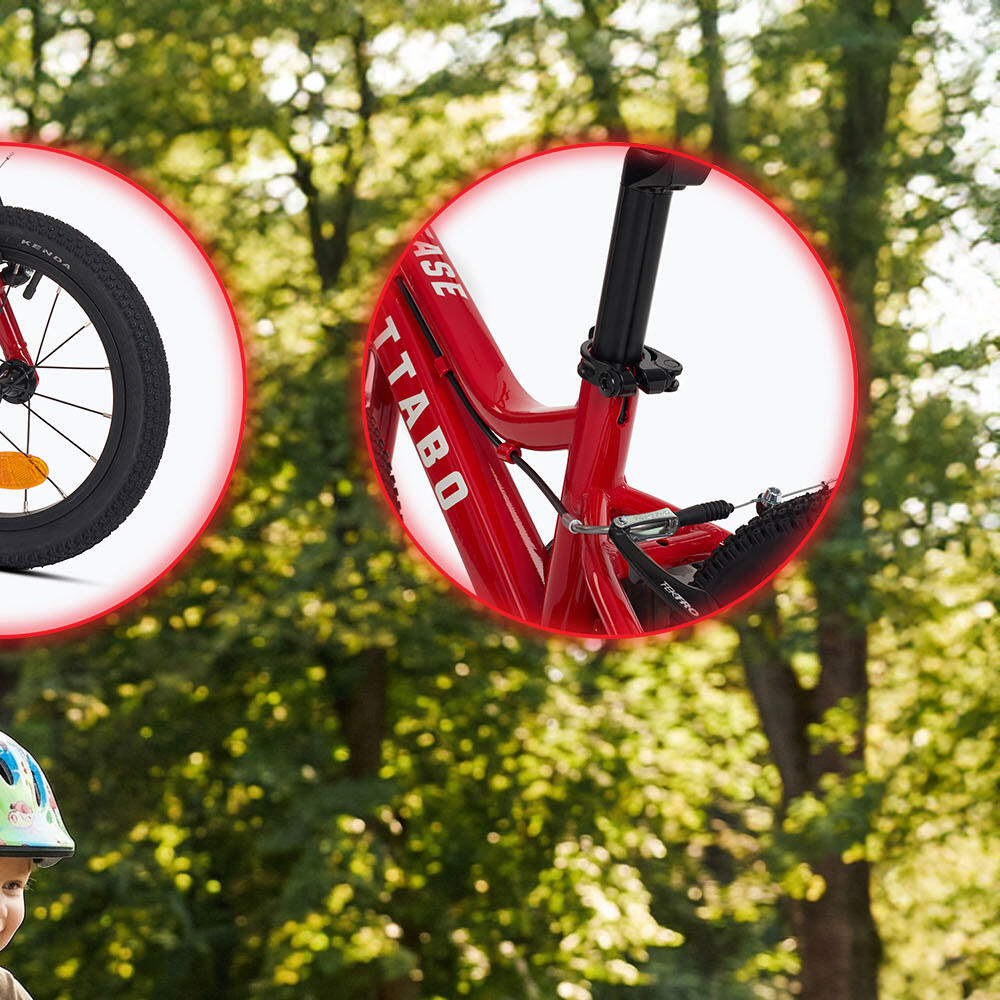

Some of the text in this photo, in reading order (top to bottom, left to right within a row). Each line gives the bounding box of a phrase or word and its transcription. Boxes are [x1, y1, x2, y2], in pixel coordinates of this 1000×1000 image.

[21, 239, 71, 270] KENDA
[413, 228, 468, 299] ASE
[660, 580, 699, 617] TEKTRO
